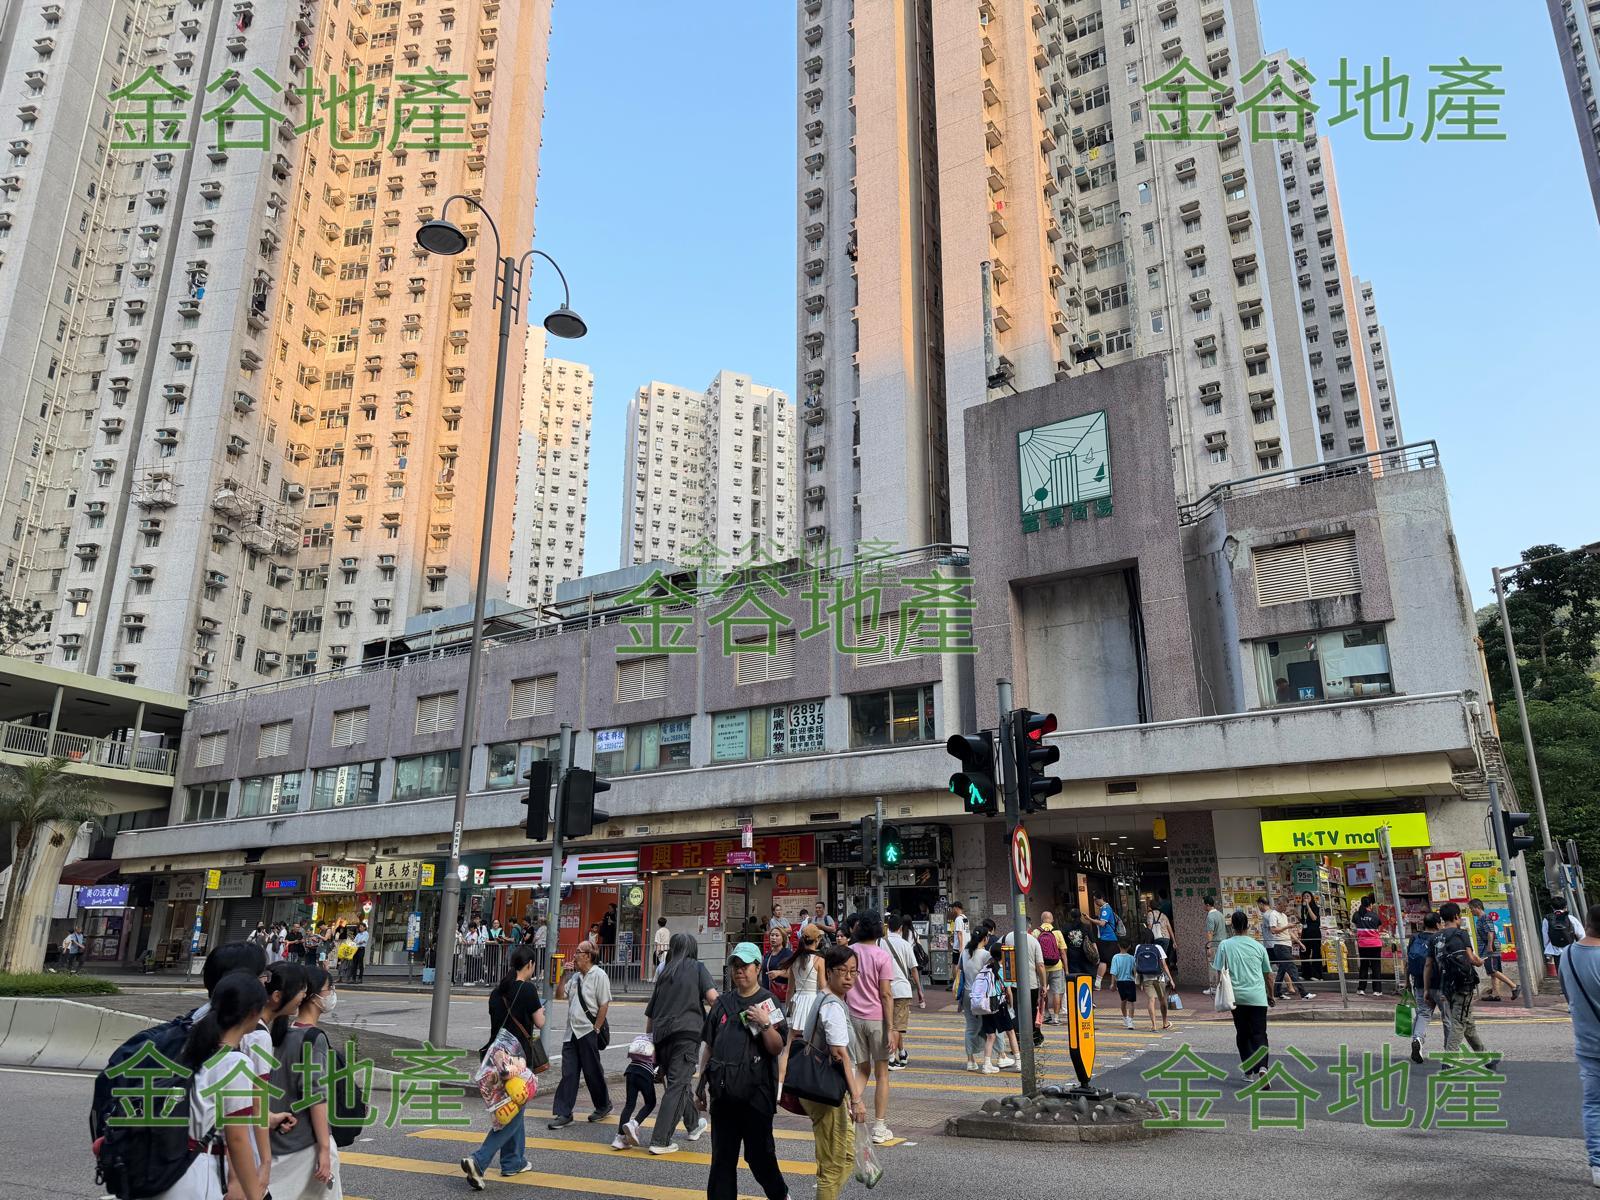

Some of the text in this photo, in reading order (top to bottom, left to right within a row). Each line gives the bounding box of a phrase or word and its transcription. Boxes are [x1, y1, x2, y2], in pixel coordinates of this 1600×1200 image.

[793, 703, 824, 715] 2897
[793, 713, 824, 727] 3335
[772, 707, 785, 754] 康麗物業
[1292, 827, 1380, 847] HKTV mal
[375, 862, 410, 879] 健民坊
